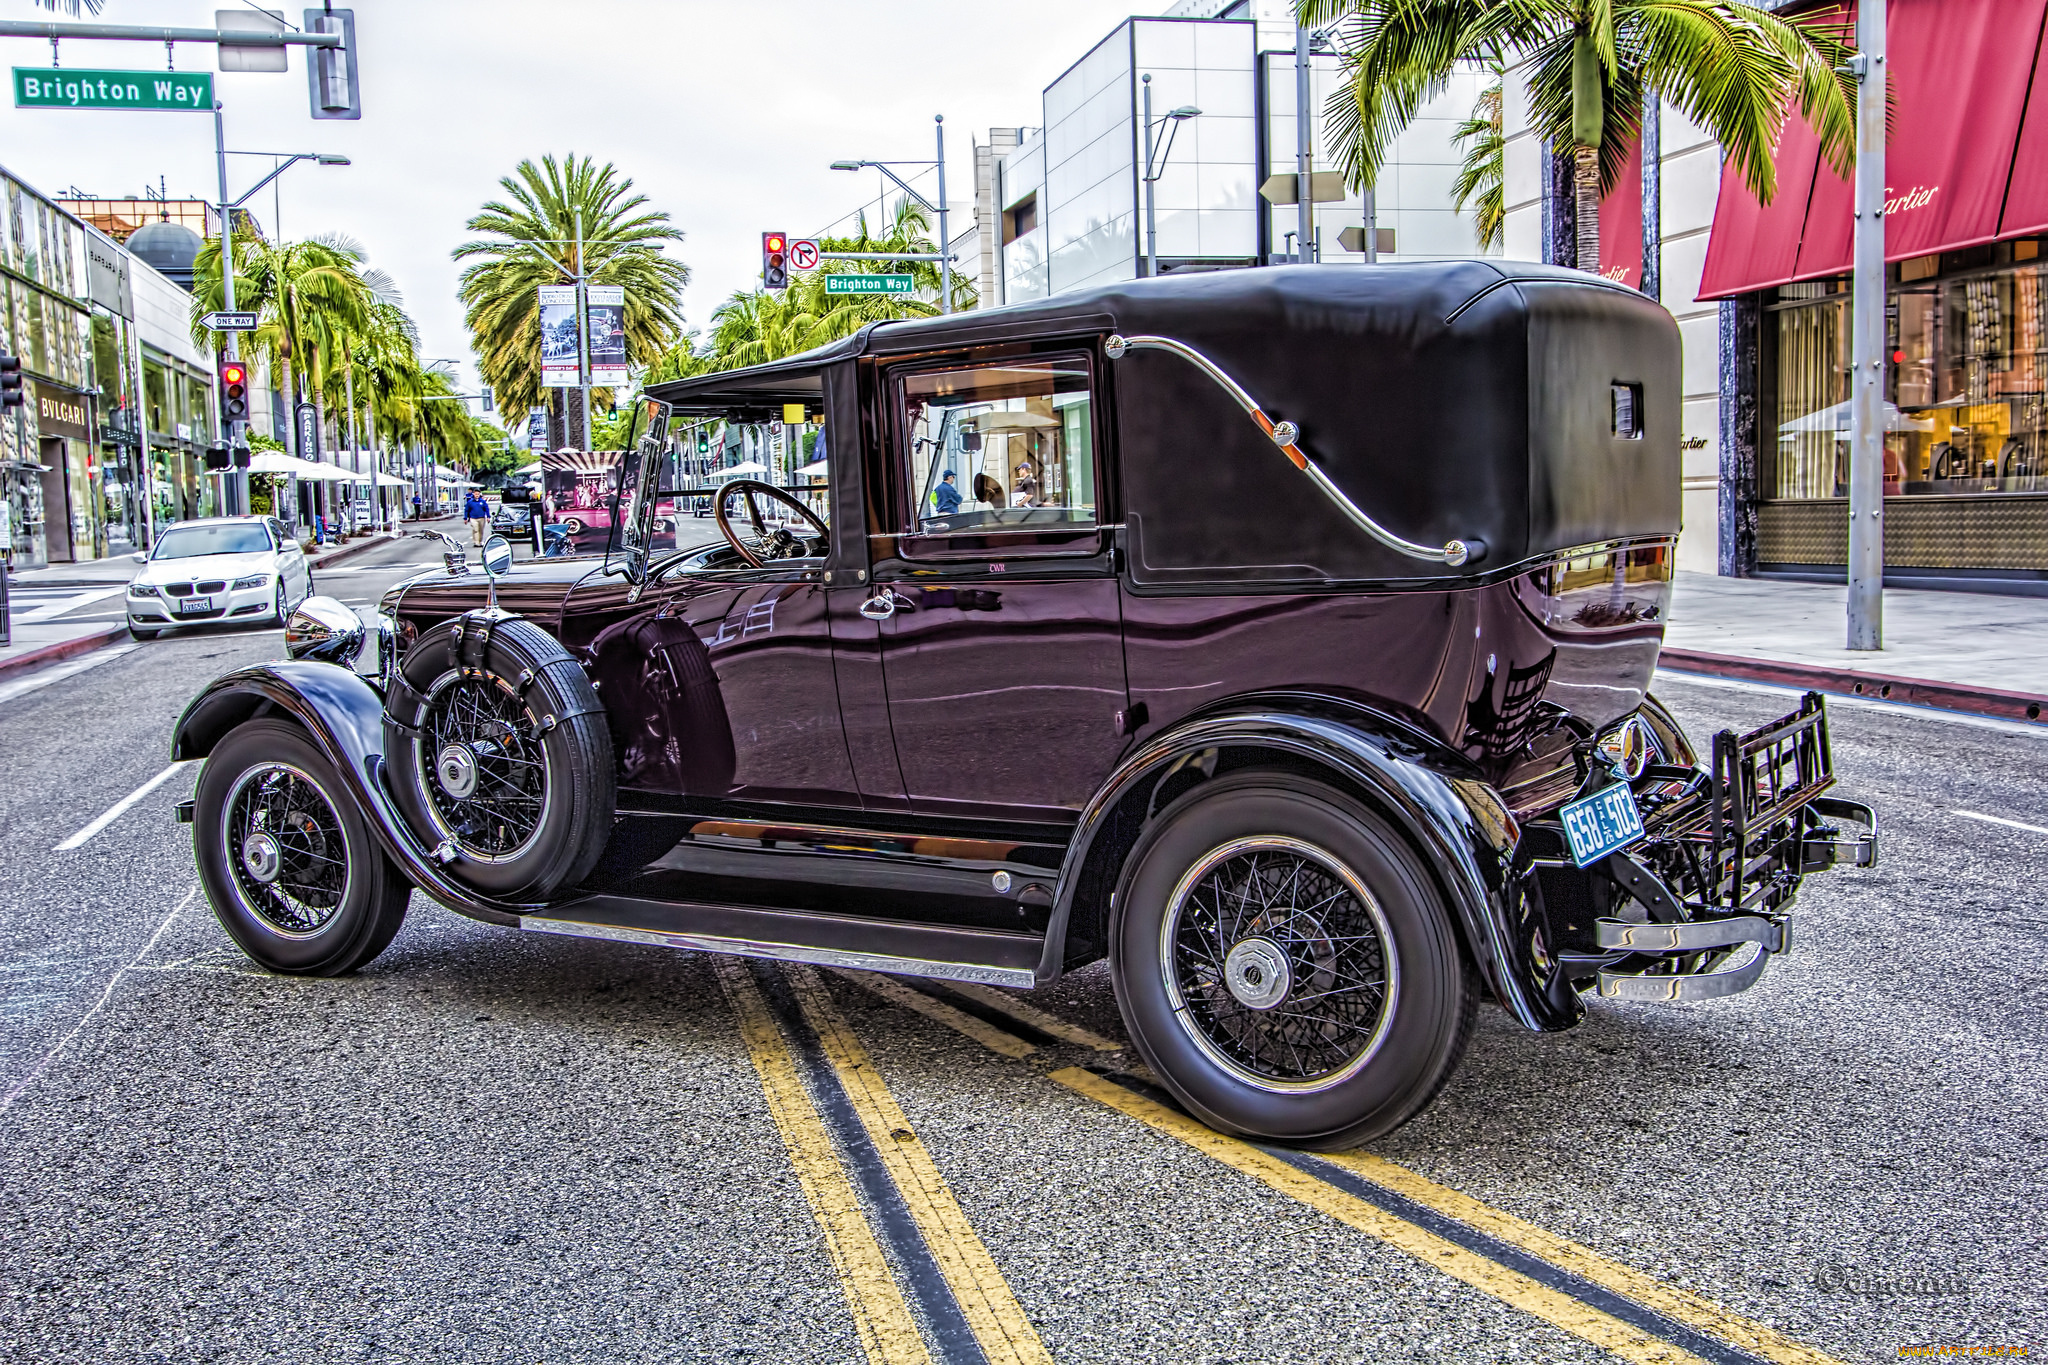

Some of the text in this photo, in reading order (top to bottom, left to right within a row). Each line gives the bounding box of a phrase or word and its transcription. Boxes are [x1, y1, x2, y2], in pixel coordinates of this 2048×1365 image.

[24, 77, 203, 107] Brighton Way
[830, 278, 909, 292] Brighton Way
[41, 397, 85, 426] BVLGARI
[303, 413, 313, 453] PARKING
[989, 563, 1005, 573] CWR
[1566, 789, 1640, 858] 658 CAL 26 503
